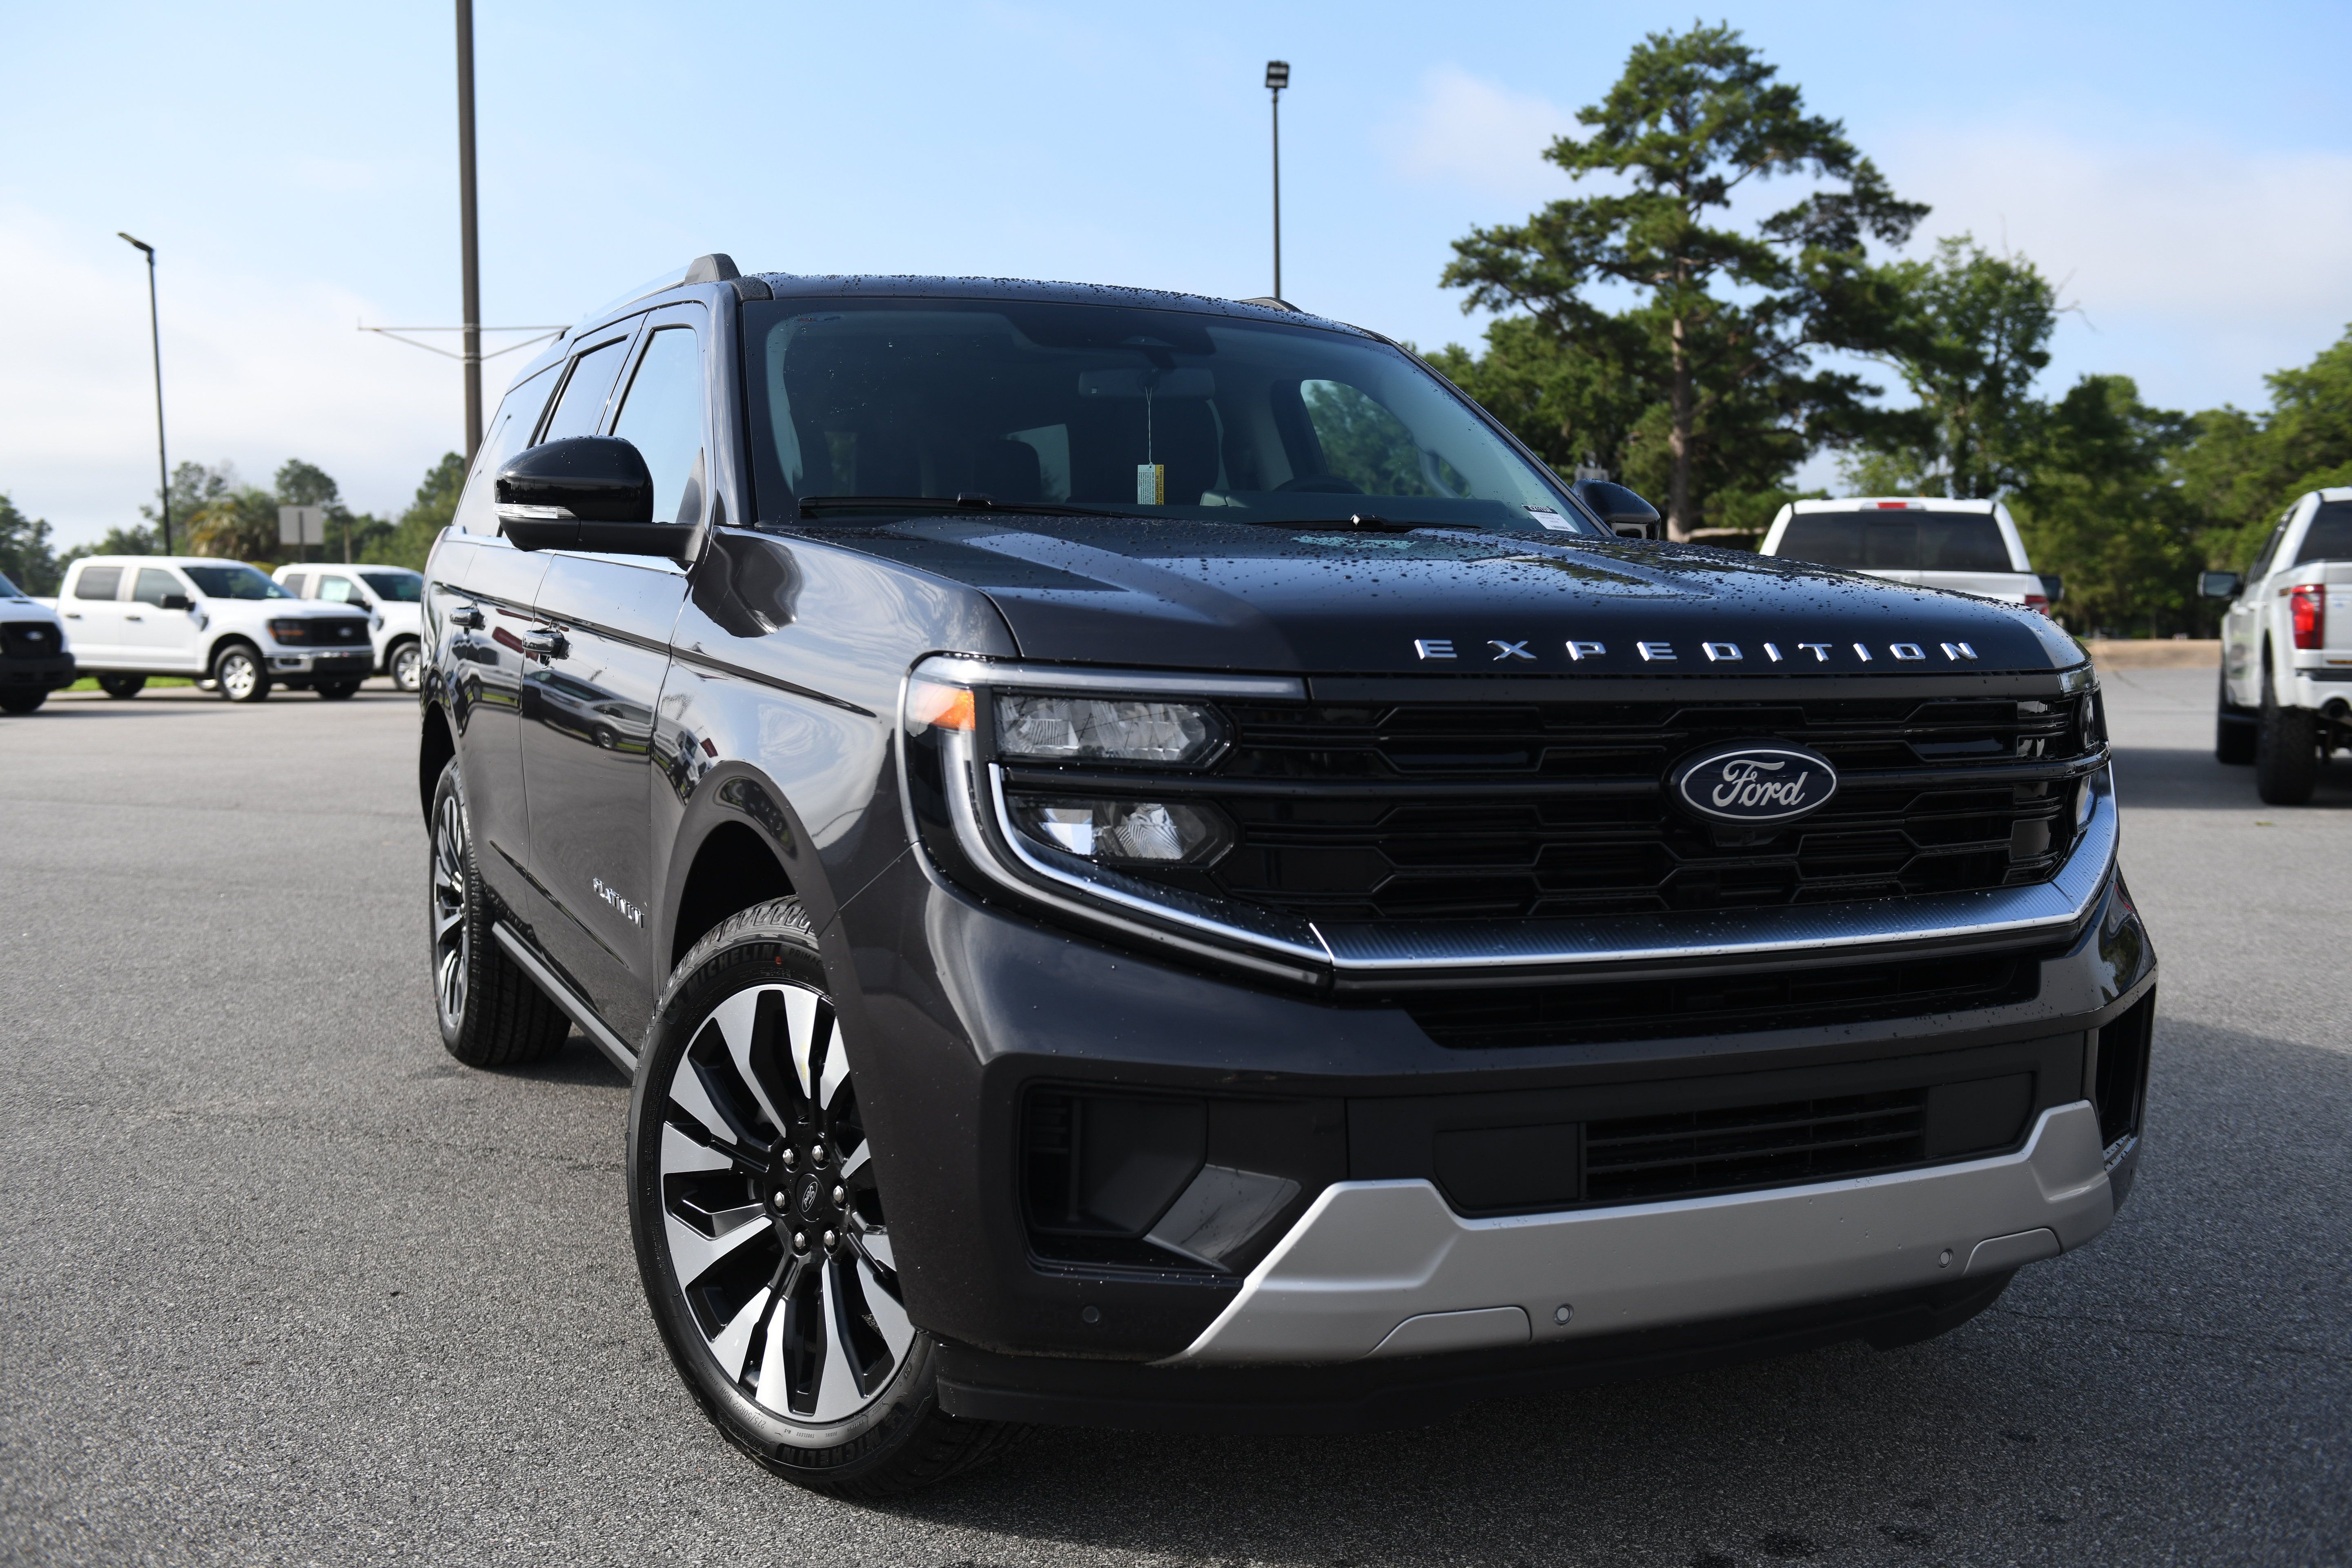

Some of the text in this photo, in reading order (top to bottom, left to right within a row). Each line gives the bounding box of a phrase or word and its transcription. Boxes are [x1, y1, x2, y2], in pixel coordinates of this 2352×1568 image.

[1414, 639, 1979, 662] EXPEDITION
[1712, 760, 1809, 807] Ford
[593, 878, 644, 928] PLATINUM
[686, 944, 775, 996] MICHELIN
[804, 1185, 815, 1207] Ford
[708, 1372, 719, 1386] EXTRA
[719, 1386, 767, 1429] 275/50R22 115H
[781, 1426, 882, 1468] MICHELIN
